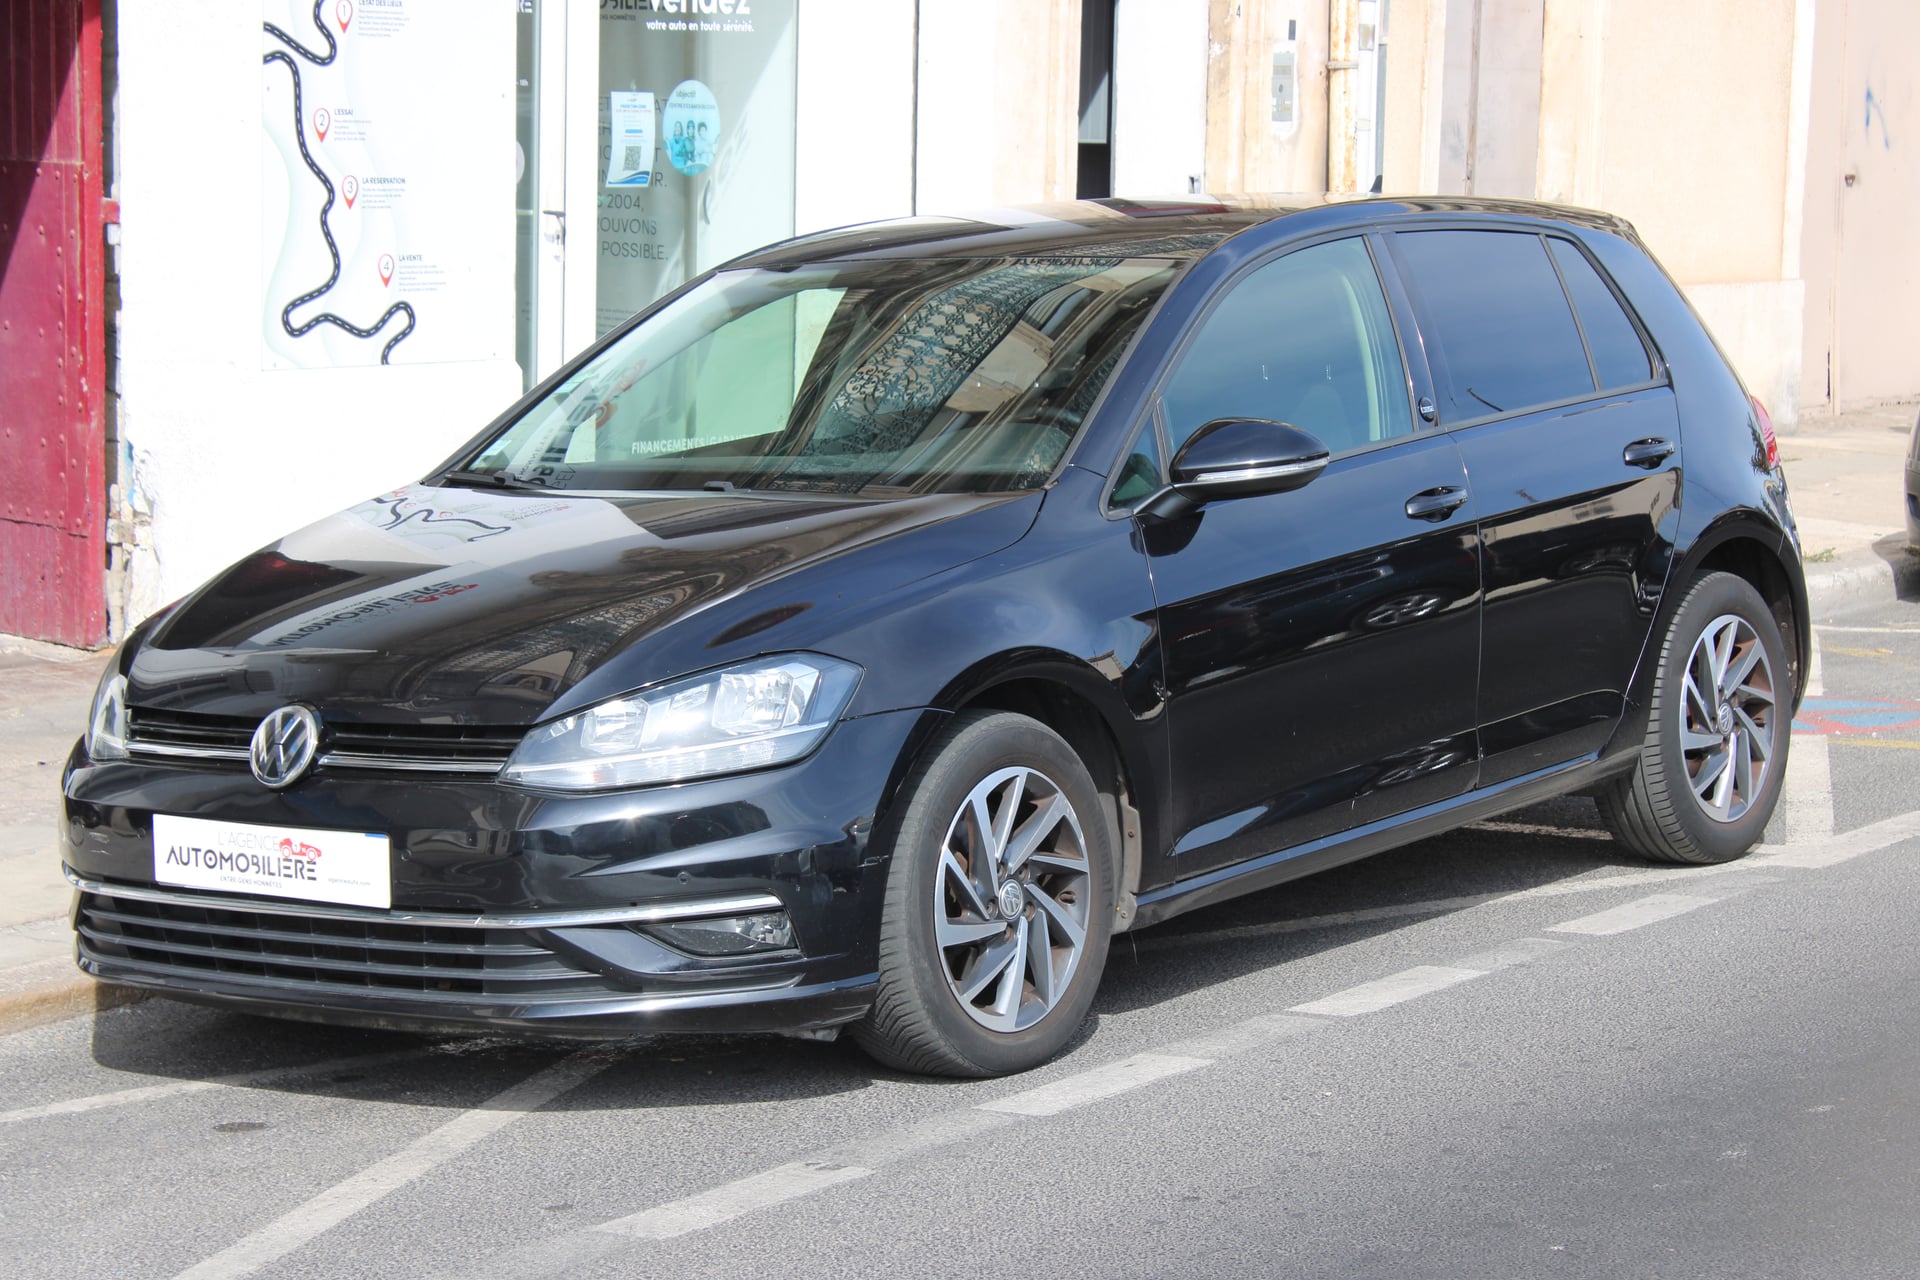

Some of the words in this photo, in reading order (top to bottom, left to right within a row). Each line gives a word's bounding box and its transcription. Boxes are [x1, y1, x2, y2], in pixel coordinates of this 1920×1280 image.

[646, 20, 667, 30] votre
[668, 20, 687, 31] auto
[688, 22, 699, 31] en
[700, 21, 721, 31] toute
[723, 20, 754, 32] sérénité.
[319, 113, 325, 127] 2
[347, 181, 353, 194] 3
[607, 193, 644, 212] 2004,
[597, 217, 657, 236] OUVONS
[602, 240, 669, 260] POSSIBLE.
[383, 260, 390, 272] 4
[631, 437, 705, 455] FINANCEMENTS
[217, 831, 281, 853] L'AGENCE
[220, 875, 237, 884] ENTRE
[238, 877, 252, 886] GENS
